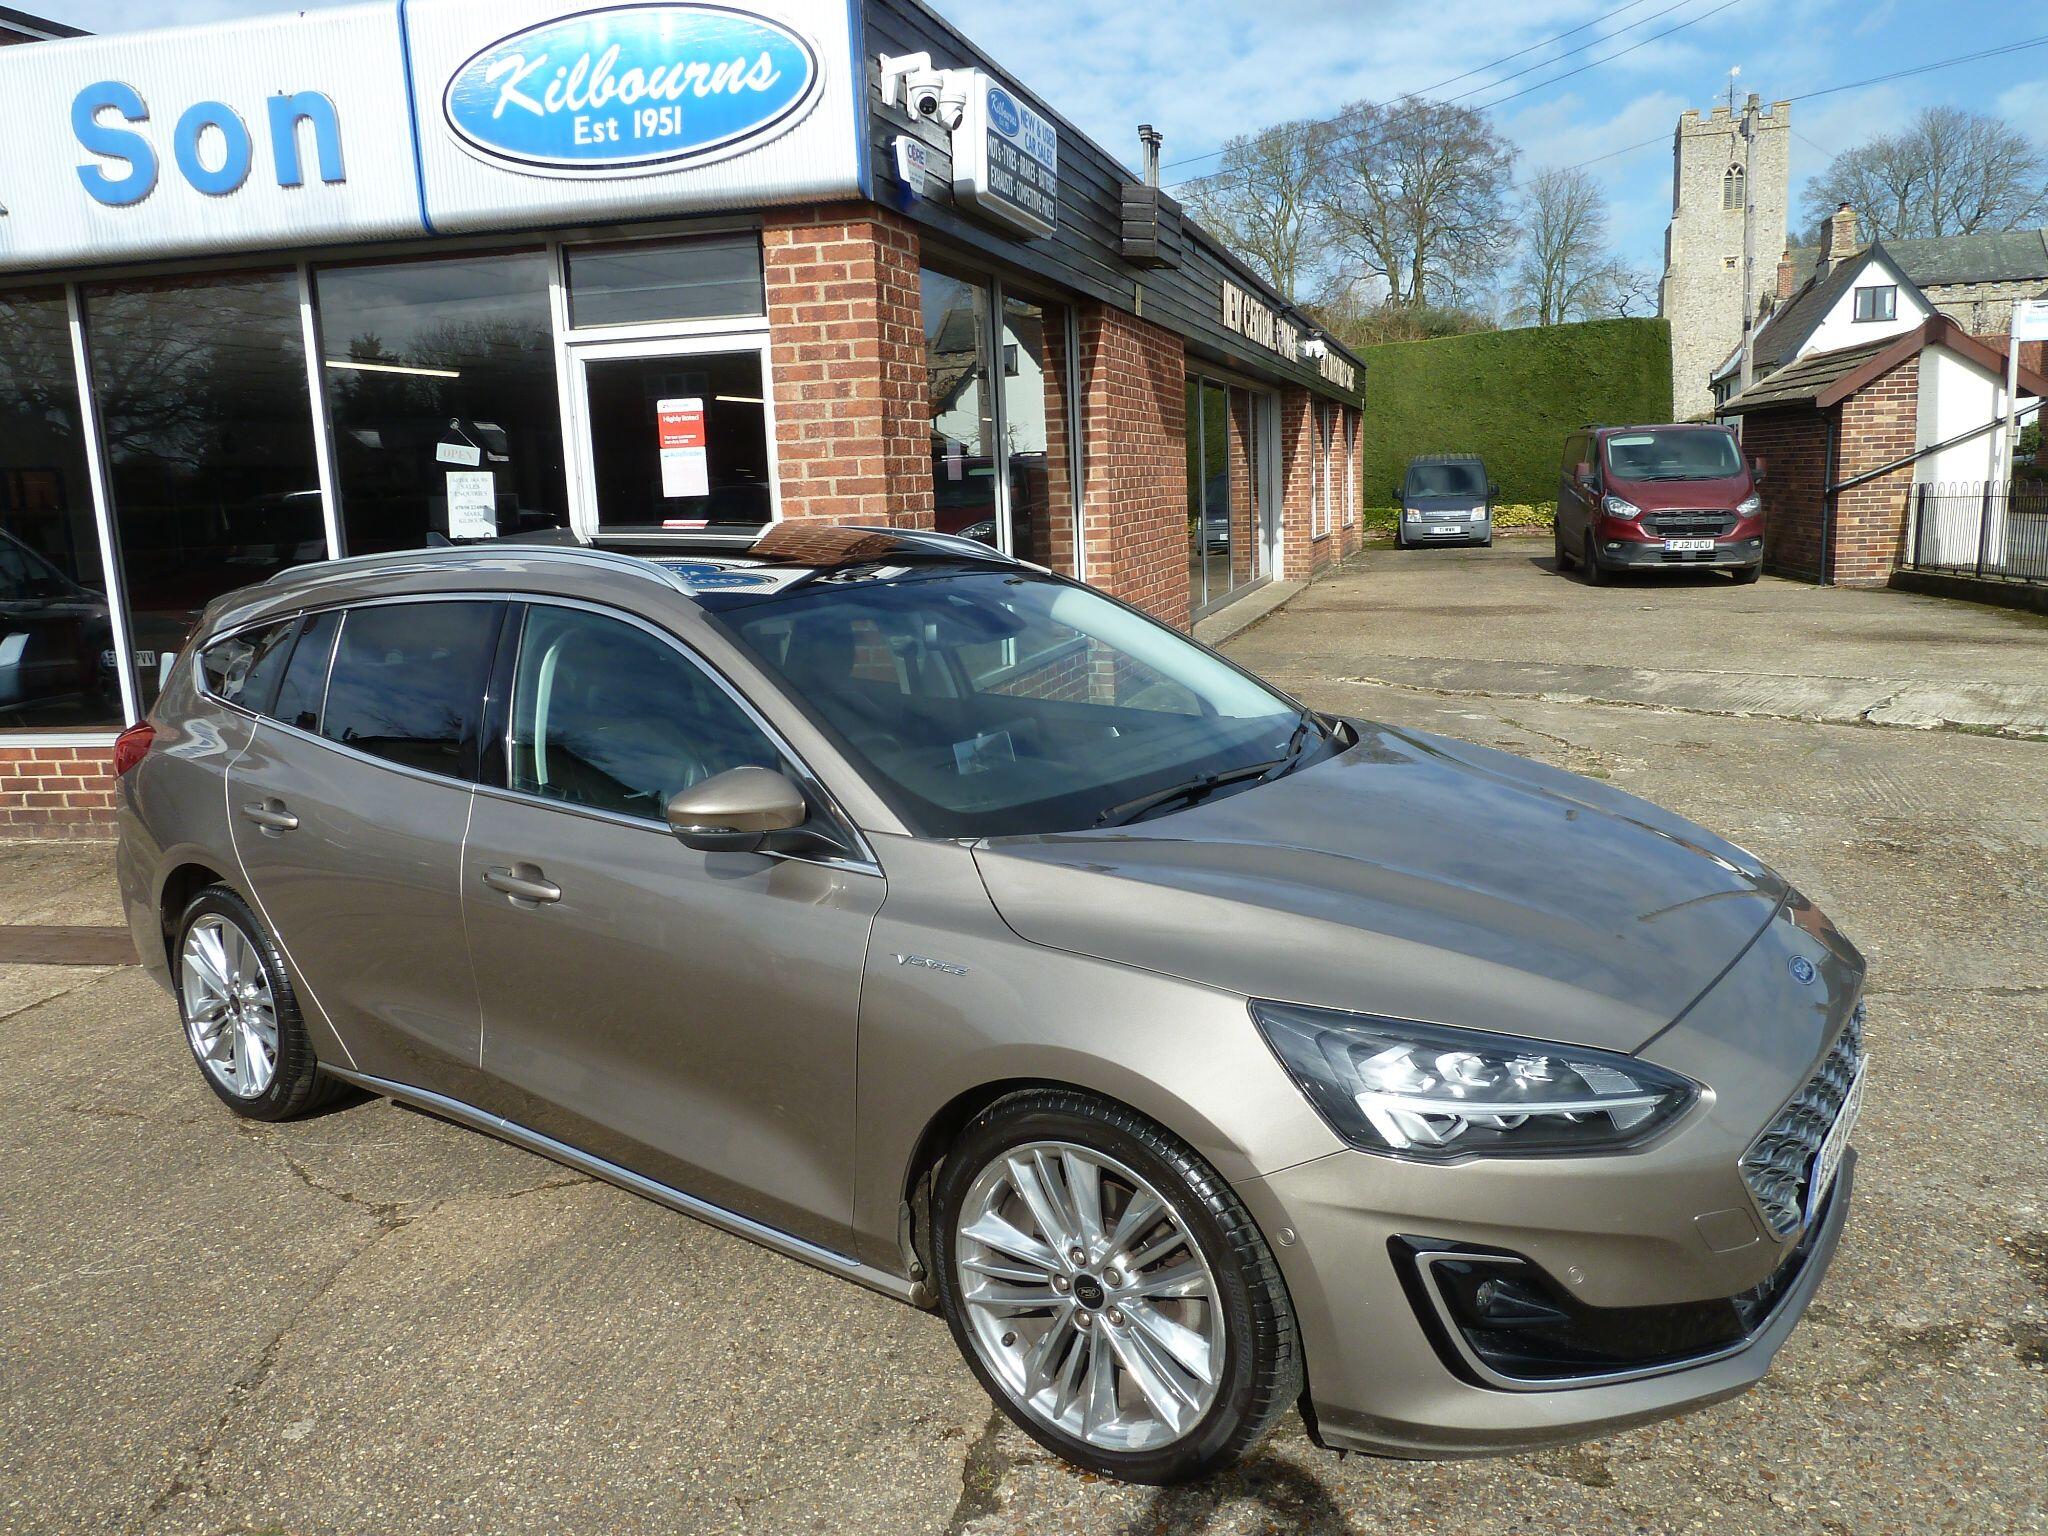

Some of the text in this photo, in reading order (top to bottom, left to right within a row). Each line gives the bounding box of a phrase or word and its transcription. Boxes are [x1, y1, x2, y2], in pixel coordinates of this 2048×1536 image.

[485, 44, 781, 119] Kilbourns
[72, 81, 345, 206] Son
[574, 105, 682, 145] Est 1951
[1020, 107, 1035, 131] NEW
[1043, 125, 1056, 149] USED
[1025, 132, 1053, 167] CAR SALES
[444, 448, 473, 461] OPEN
[1672, 541, 1711, 549] FJ21 UCU
